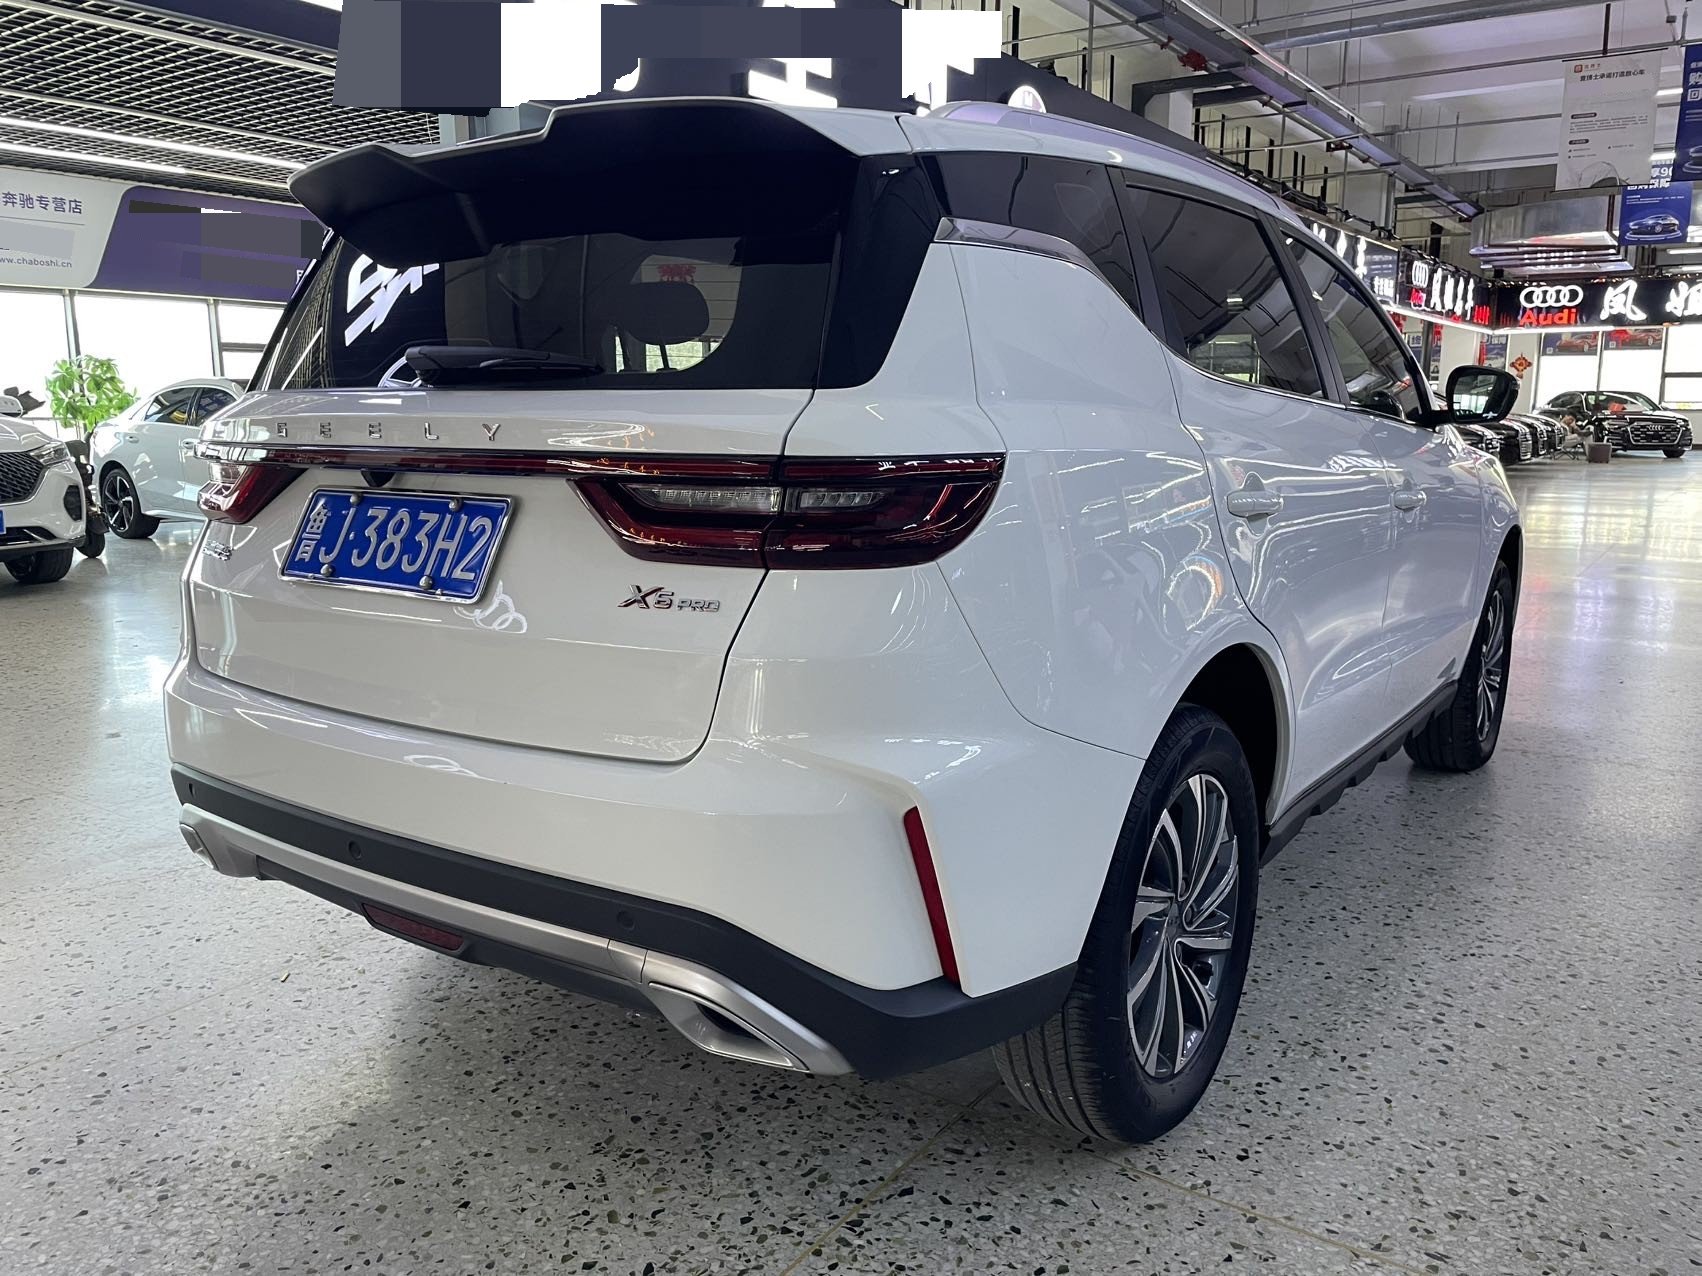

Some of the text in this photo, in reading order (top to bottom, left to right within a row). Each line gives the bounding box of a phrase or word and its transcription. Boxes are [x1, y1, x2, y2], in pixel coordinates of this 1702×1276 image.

[2, 191, 82, 214] 奔驰专营店
[1519, 308, 1578, 325] Audi
[277, 422, 501, 441] GEELY
[677, 598, 720, 613] PRO
